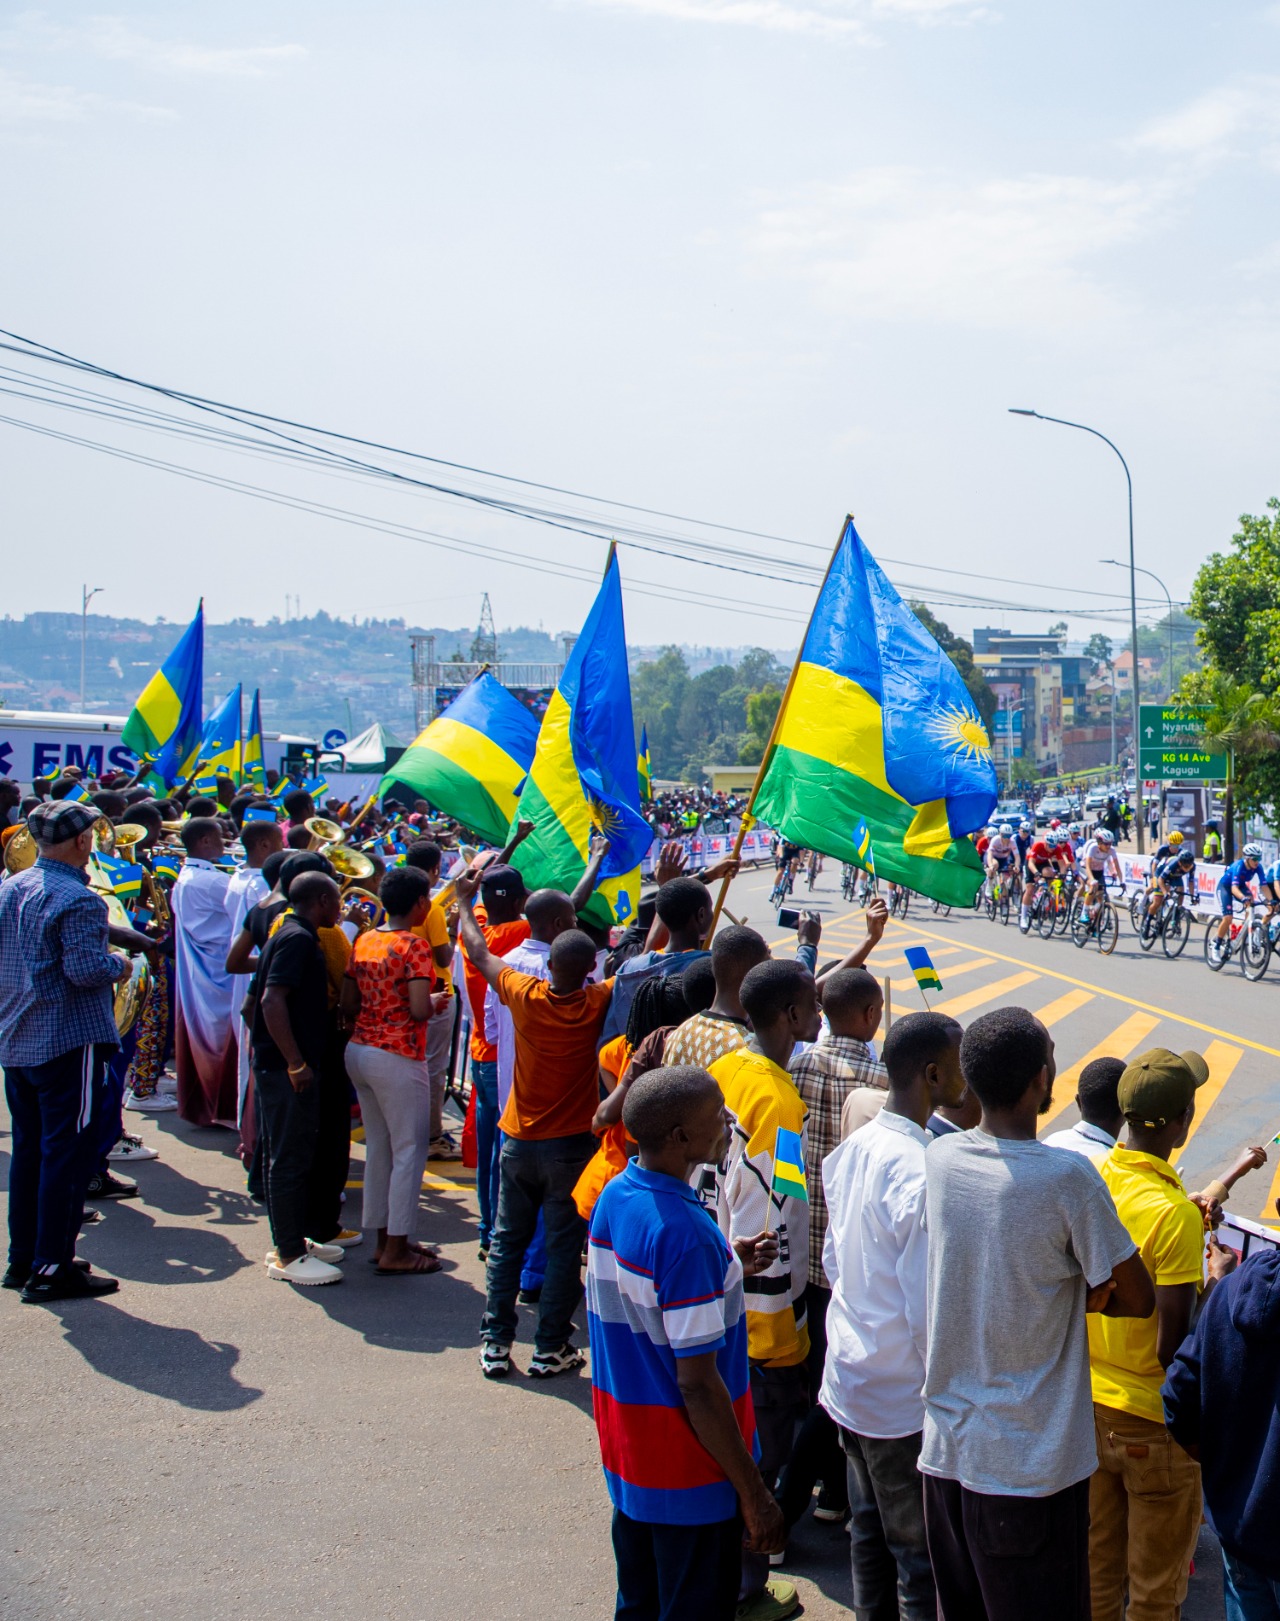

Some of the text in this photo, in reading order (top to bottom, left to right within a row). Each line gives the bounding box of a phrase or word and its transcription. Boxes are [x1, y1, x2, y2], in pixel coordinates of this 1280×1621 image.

[32, 742, 136, 779] EMS
[1162, 753, 1211, 762] KG 14 Ave
[1162, 765, 1200, 776] Kagugu
